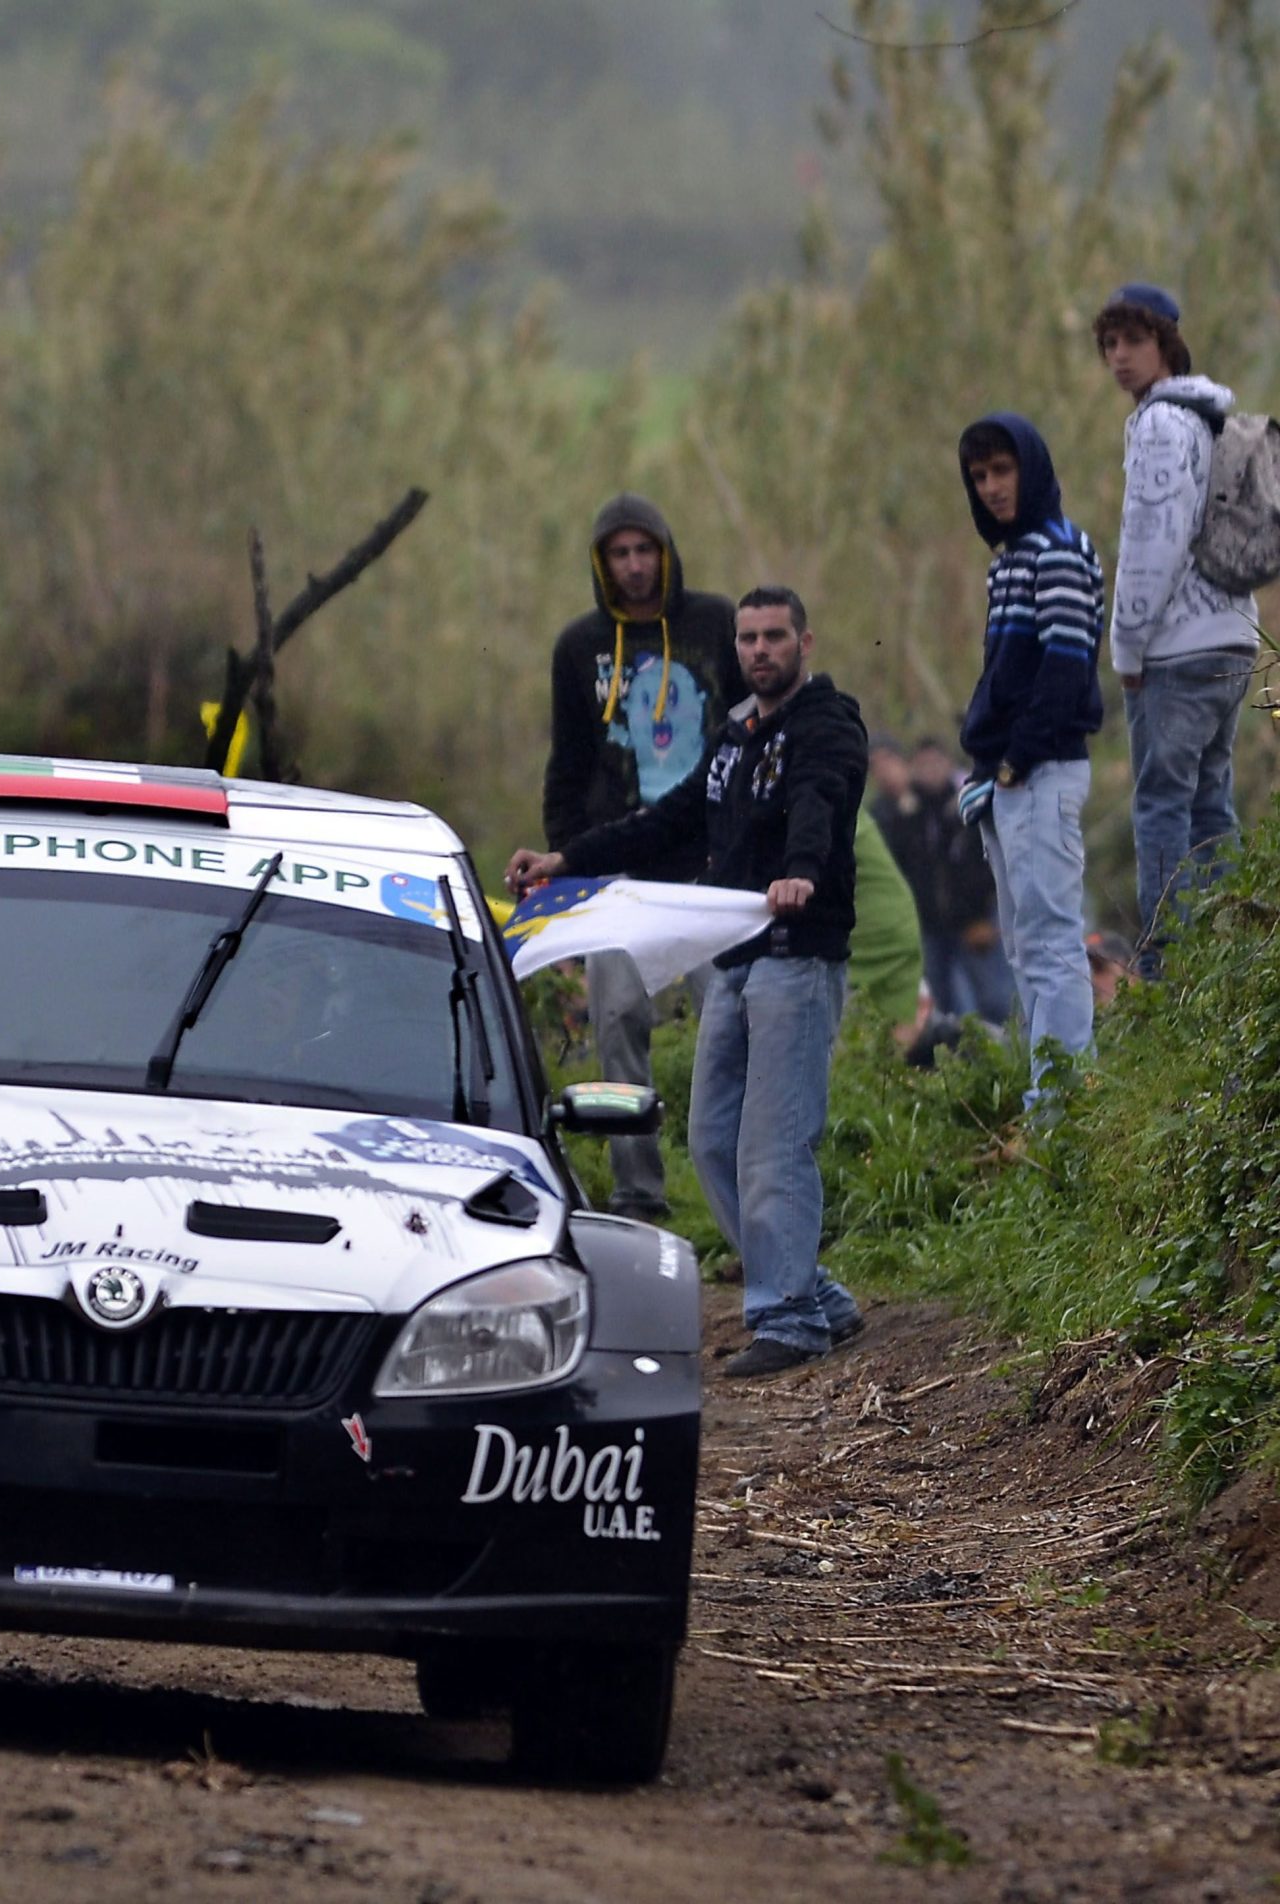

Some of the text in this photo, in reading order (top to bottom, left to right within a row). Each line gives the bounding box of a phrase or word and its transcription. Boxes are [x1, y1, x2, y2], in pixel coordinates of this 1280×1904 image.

[247, 857, 371, 893] APP
[40, 1241, 199, 1273] JM Racing
[461, 1424, 645, 1504] Dubai
[583, 1505, 661, 1541] U.A.E.
